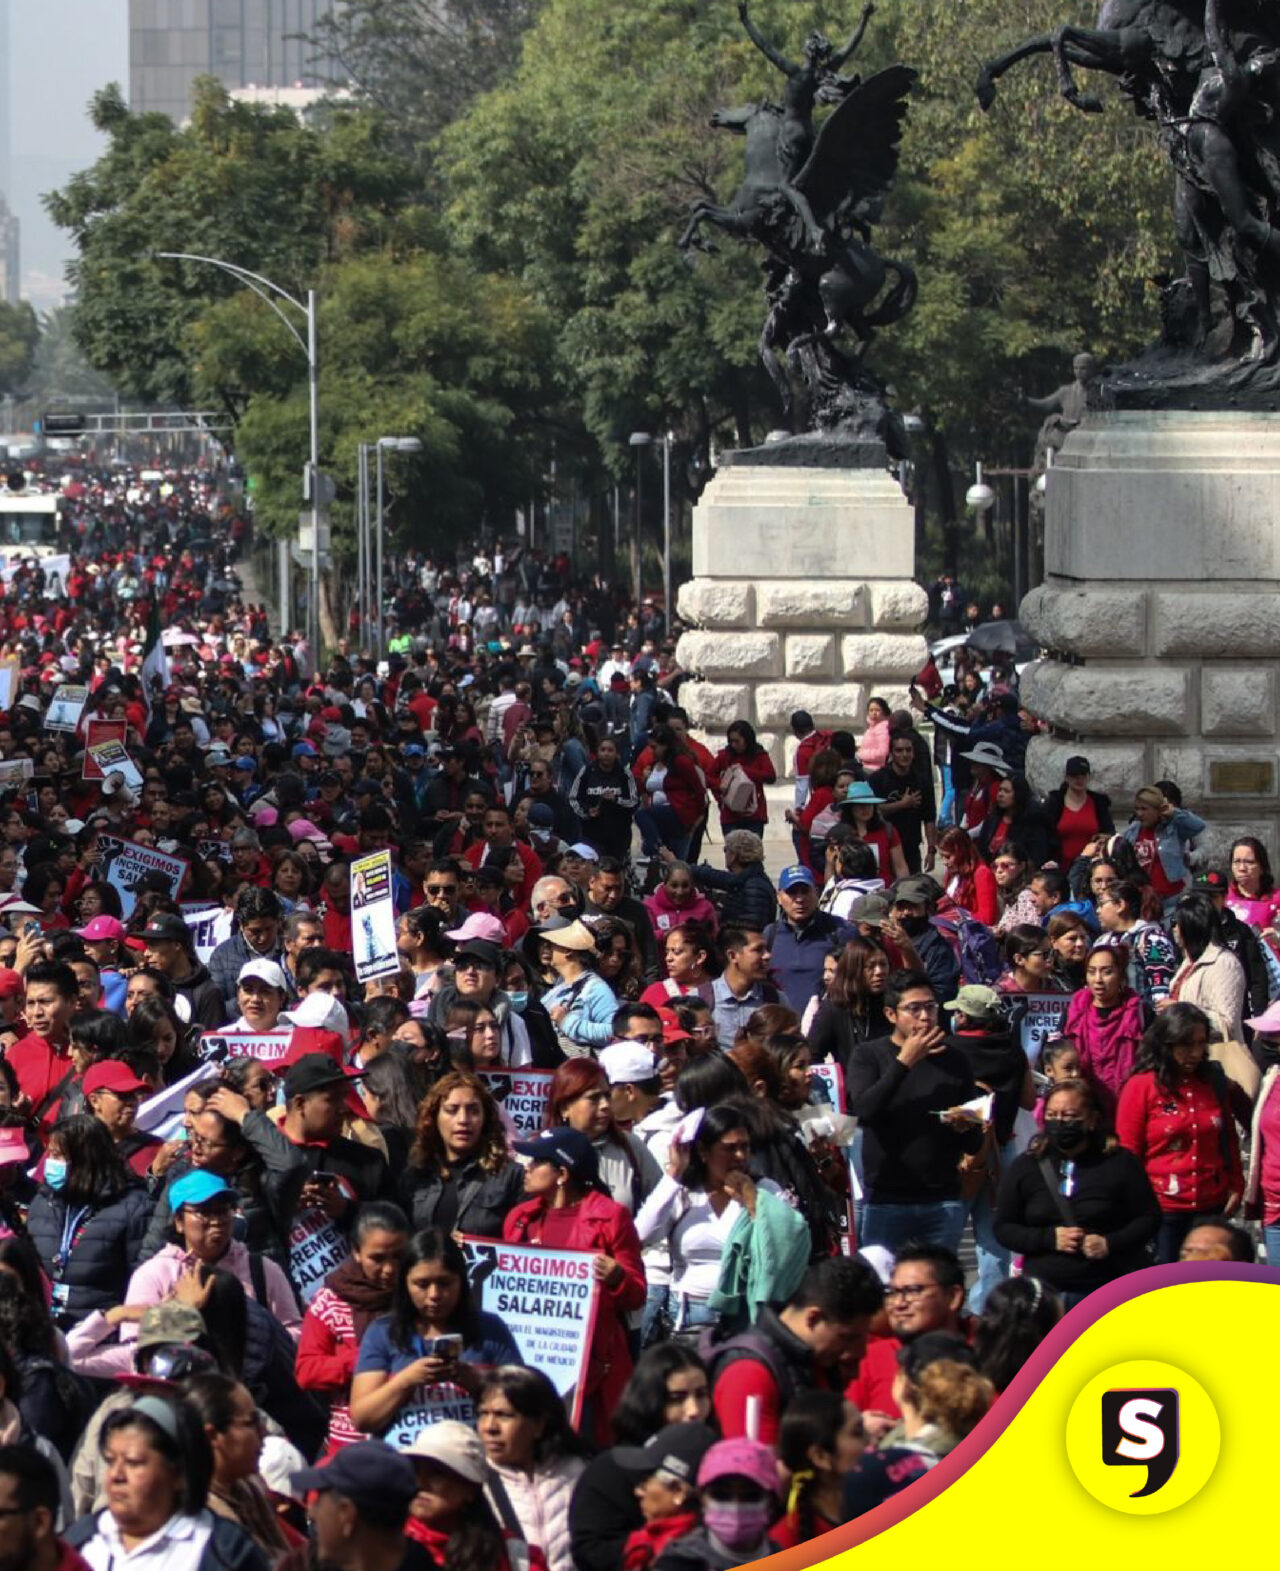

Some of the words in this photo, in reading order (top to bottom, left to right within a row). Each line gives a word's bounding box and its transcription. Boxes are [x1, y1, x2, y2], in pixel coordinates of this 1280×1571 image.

[123, 846, 180, 876] EXIGIMOS
[498, 1253, 589, 1280] EXIGIMOS
[490, 1275, 589, 1299] INCREMENTO
[497, 1294, 583, 1321] SALARIAL
